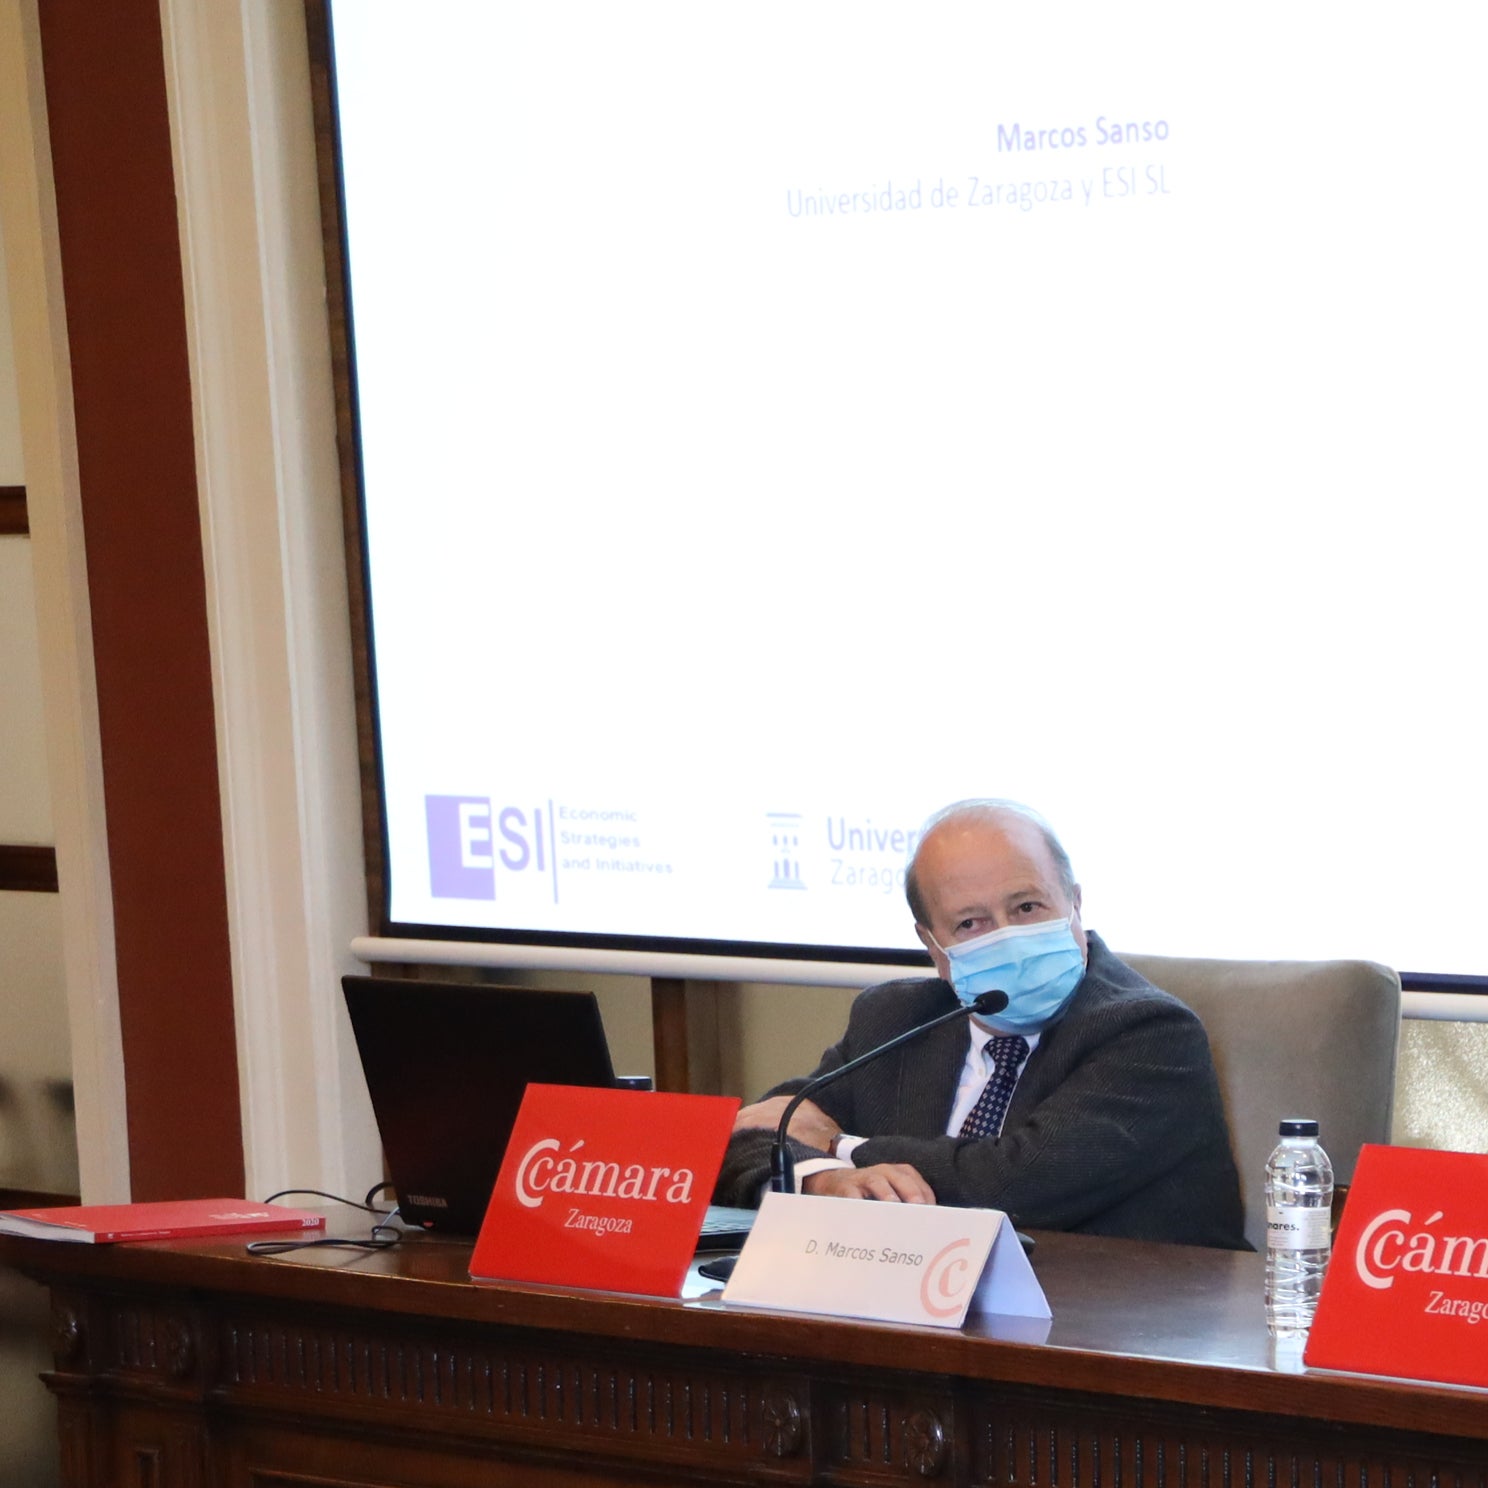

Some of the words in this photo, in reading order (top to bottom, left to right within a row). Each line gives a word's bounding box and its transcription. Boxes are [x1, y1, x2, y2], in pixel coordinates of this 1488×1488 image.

[996, 121, 1088, 153] Marcos
[1095, 115, 1171, 146] Sanso
[786, 179, 922, 217] Universidad
[930, 176, 960, 209] de
[967, 174, 1074, 213] Zaragoza
[1081, 174, 1095, 208] y
[1102, 165, 1138, 199] ESI
[1145, 163, 1172, 196] SL
[558, 805, 638, 823] Economic
[459, 803, 546, 872] ESI
[560, 830, 641, 850] Strategies
[561, 857, 591, 871] and
[596, 857, 674, 875] Initiatives
[564, 1208, 633, 1236] Zaragoza
[804, 1239, 819, 1256] D.
[824, 1241, 876, 1262] Marcos
[878, 1247, 923, 1267] Sanso
